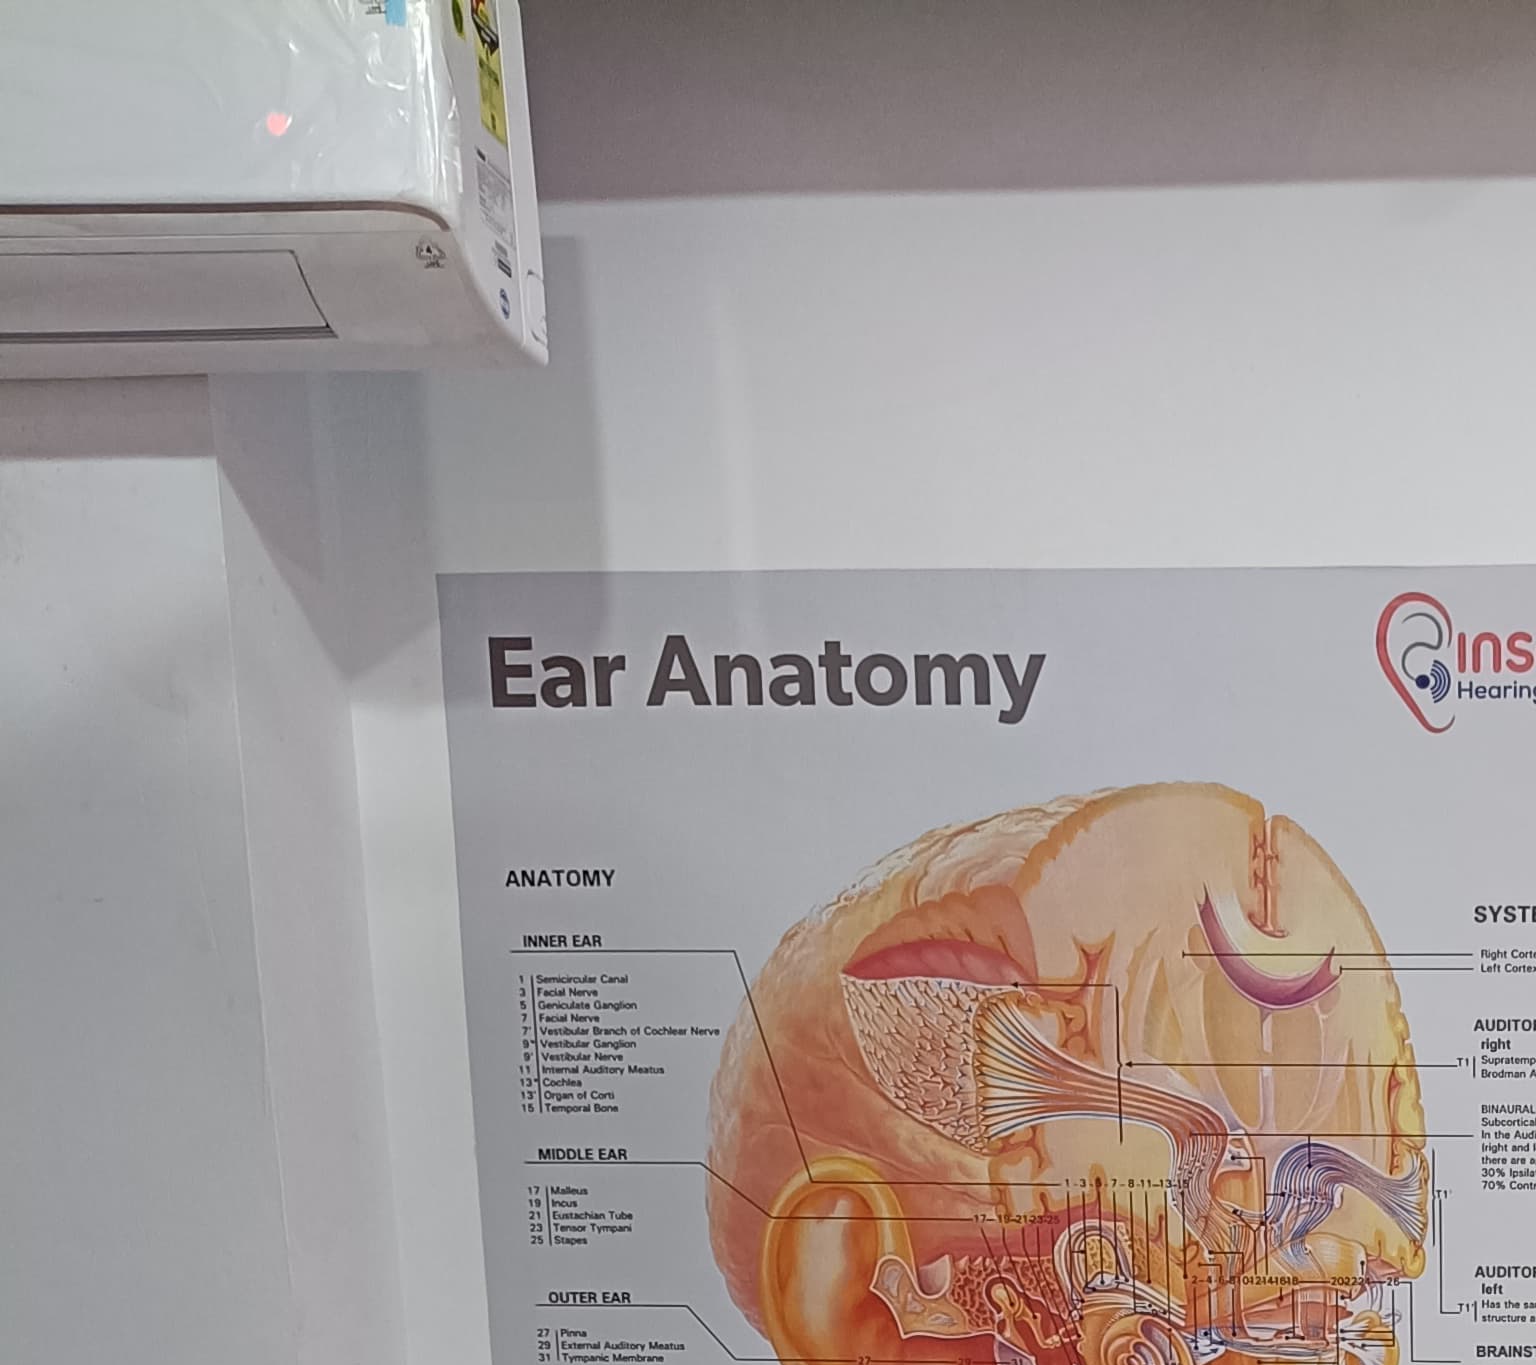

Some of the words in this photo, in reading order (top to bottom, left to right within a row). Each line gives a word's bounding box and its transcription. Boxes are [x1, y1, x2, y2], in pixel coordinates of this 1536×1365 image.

[488, 637, 626, 708] Ear
[646, 634, 1047, 724] Anatomy
[505, 869, 615, 888] ANATOMY
[523, 935, 567, 948] INNER
[572, 935, 602, 948] EAR
[1481, 949, 1507, 961] Right
[1481, 963, 1501, 973] Left
[536, 975, 597, 984] Semicircular
[600, 975, 629, 984] Canal
[537, 988, 566, 997] Facial
[569, 988, 599, 997] Nerve
[520, 1001, 527, 1010] 5
[538, 1001, 591, 1010] Geniculate
[594, 1001, 638, 1012] Ganglion
[540, 1027, 589, 1036] Vestibular
[593, 1027, 627, 1036] Branch
[631, 1027, 641, 1036] of
[644, 1027, 687, 1036] Cochlear
[691, 1027, 720, 1036] Nerve
[1481, 1038, 1511, 1053] right
[1457, 1058, 1469, 1067] T1
[1481, 1069, 1526, 1079] Brodman
[542, 1078, 582, 1087] Cochlea
[544, 1091, 574, 1102] Organ
[577, 1091, 587, 1100] of
[591, 1091, 615, 1100] Corti
[545, 1104, 591, 1115] Temporal
[594, 1104, 619, 1113] Bone
[1481, 1104, 1536, 1114] BINAURAL
[1494, 1130, 1510, 1140] the
[1512, 1143, 1530, 1152] and
[538, 1149, 594, 1161] MIDDLE
[598, 1149, 628, 1161] EAR
[1481, 1156, 1507, 1165] there
[1481, 1168, 1506, 1178] 30%
[1482, 1181, 1506, 1190] 70%
[528, 1187, 540, 1196] 17
[551, 1187, 588, 1196] Malleus
[552, 1199, 578, 1208] Incus
[553, 1211, 606, 1220] Eustachian
[609, 1211, 633, 1220] Tube
[530, 1224, 543, 1233] 23
[554, 1224, 586, 1233] Tensor
[590, 1224, 632, 1235] Tympani
[554, 1236, 588, 1247] Stapes
[1481, 1283, 1504, 1295] left
[548, 1292, 597, 1304] OUTER
[602, 1292, 631, 1304] EAR
[1481, 1300, 1501, 1310] Has
[1504, 1300, 1520, 1310] the
[1482, 1314, 1527, 1323] structure
[537, 1329, 550, 1338] 27
[561, 1329, 587, 1338] Pinna
[561, 1342, 600, 1350] External
[604, 1342, 646, 1352] Auditory
[649, 1342, 685, 1350] Meatus
[563, 1354, 609, 1364] Tympanic
[612, 1354, 664, 1363] Membrane
